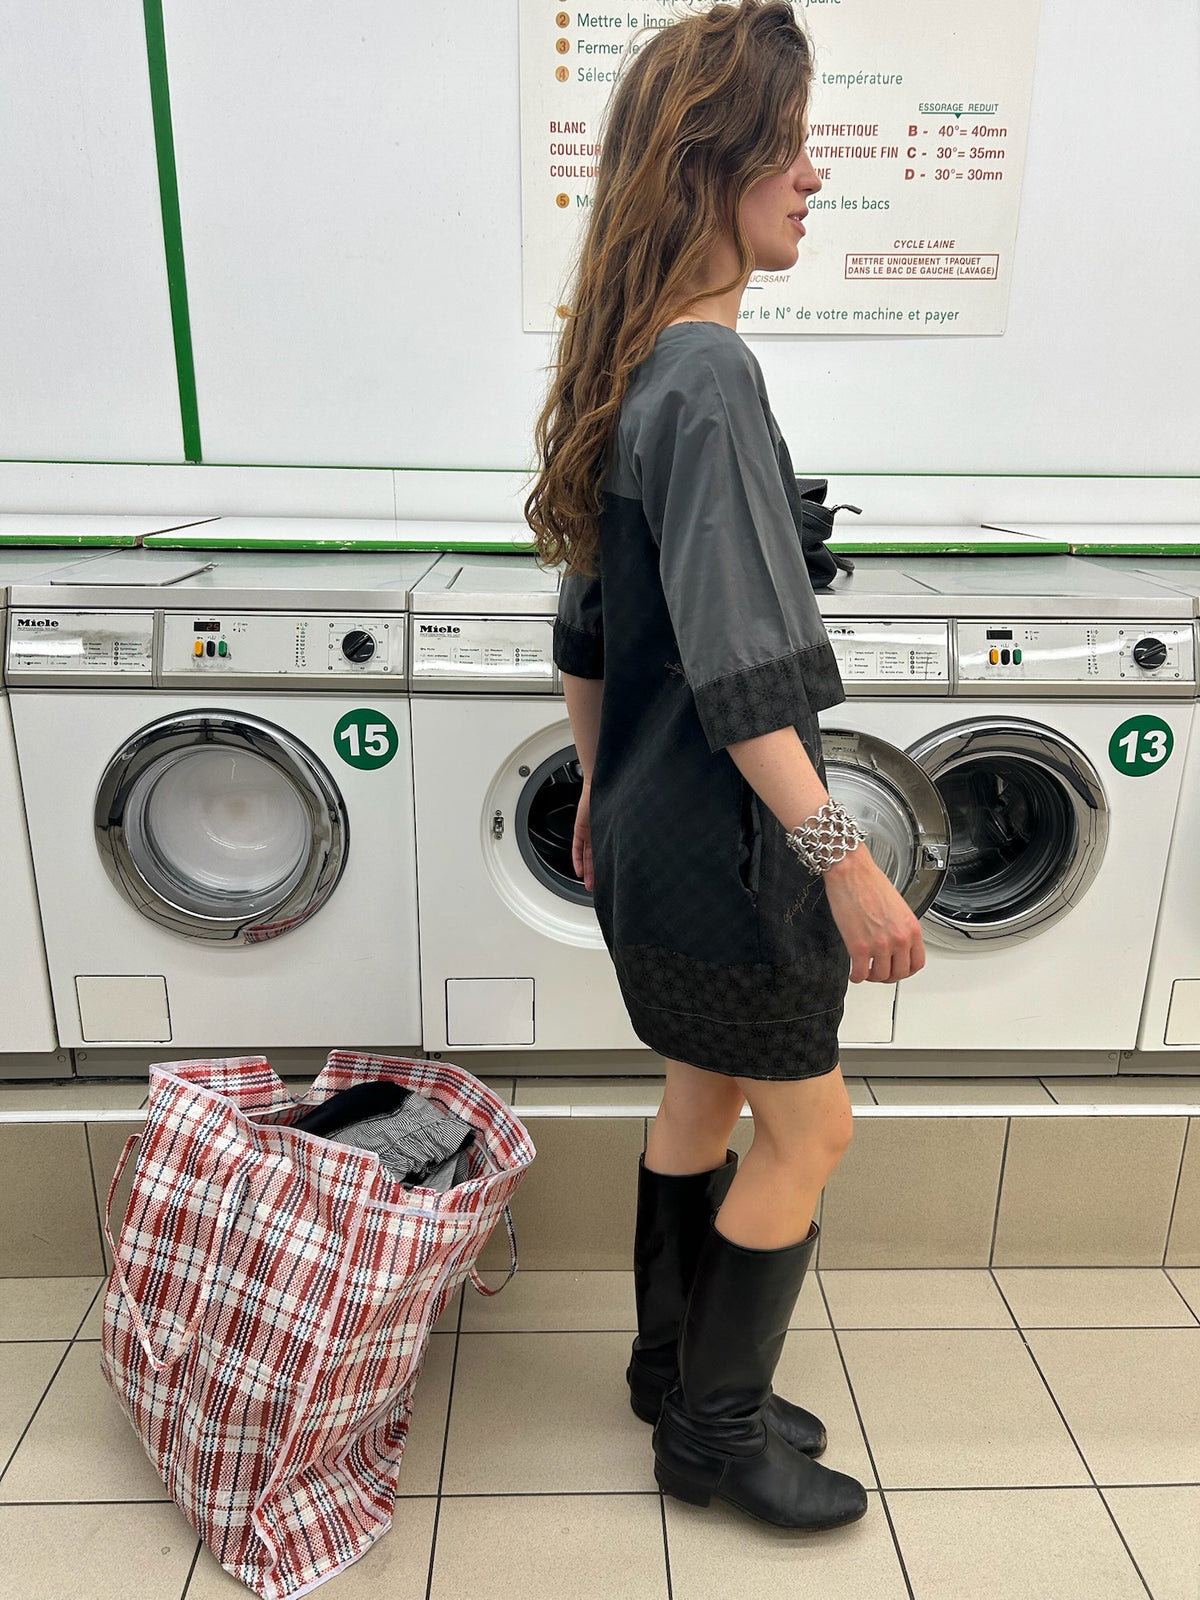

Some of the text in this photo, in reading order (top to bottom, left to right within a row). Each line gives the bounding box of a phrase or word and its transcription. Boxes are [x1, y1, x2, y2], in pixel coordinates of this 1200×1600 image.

[559, 14, 567, 26] 2
[577, 13, 622, 28] Mettre
[627, 13, 638, 28] le
[559, 40, 640, 54] 3 Fermer le
[559, 67, 617, 82] 4 Sélect
[822, 70, 903, 89] température
[918, 103, 999, 111] ESSORAGE REDUIT
[550, 121, 586, 134] BLANC
[809, 124, 879, 137] YNTHETIQUE
[908, 125, 918, 137] B
[971, 125, 1007, 137] 40mn
[808, 146, 899, 159] YNTHETIQUE FIN
[906, 146, 917, 159] C
[969, 147, 1005, 159] 35mn
[904, 168, 915, 180] D
[967, 168, 1003, 181] 30mn
[559, 195, 567, 207] 5
[807, 195, 890, 210] dans les bacs
[893, 239, 956, 249] CYCLE LAINE
[851, 257, 884, 266] METTRE
[887, 257, 941, 266] UNIQUEMENT
[848, 266, 995, 276] DANS LE BAC DE GAUCHE (LAVAGE)
[749, 274, 791, 283] UCISSANT
[737, 306, 959, 324] ser le N° de votre machine et payer
[17, 618, 60, 628] Miele
[420, 625, 461, 633] Miele
[340, 723, 390, 757] 15
[1118, 729, 1168, 764] 13
